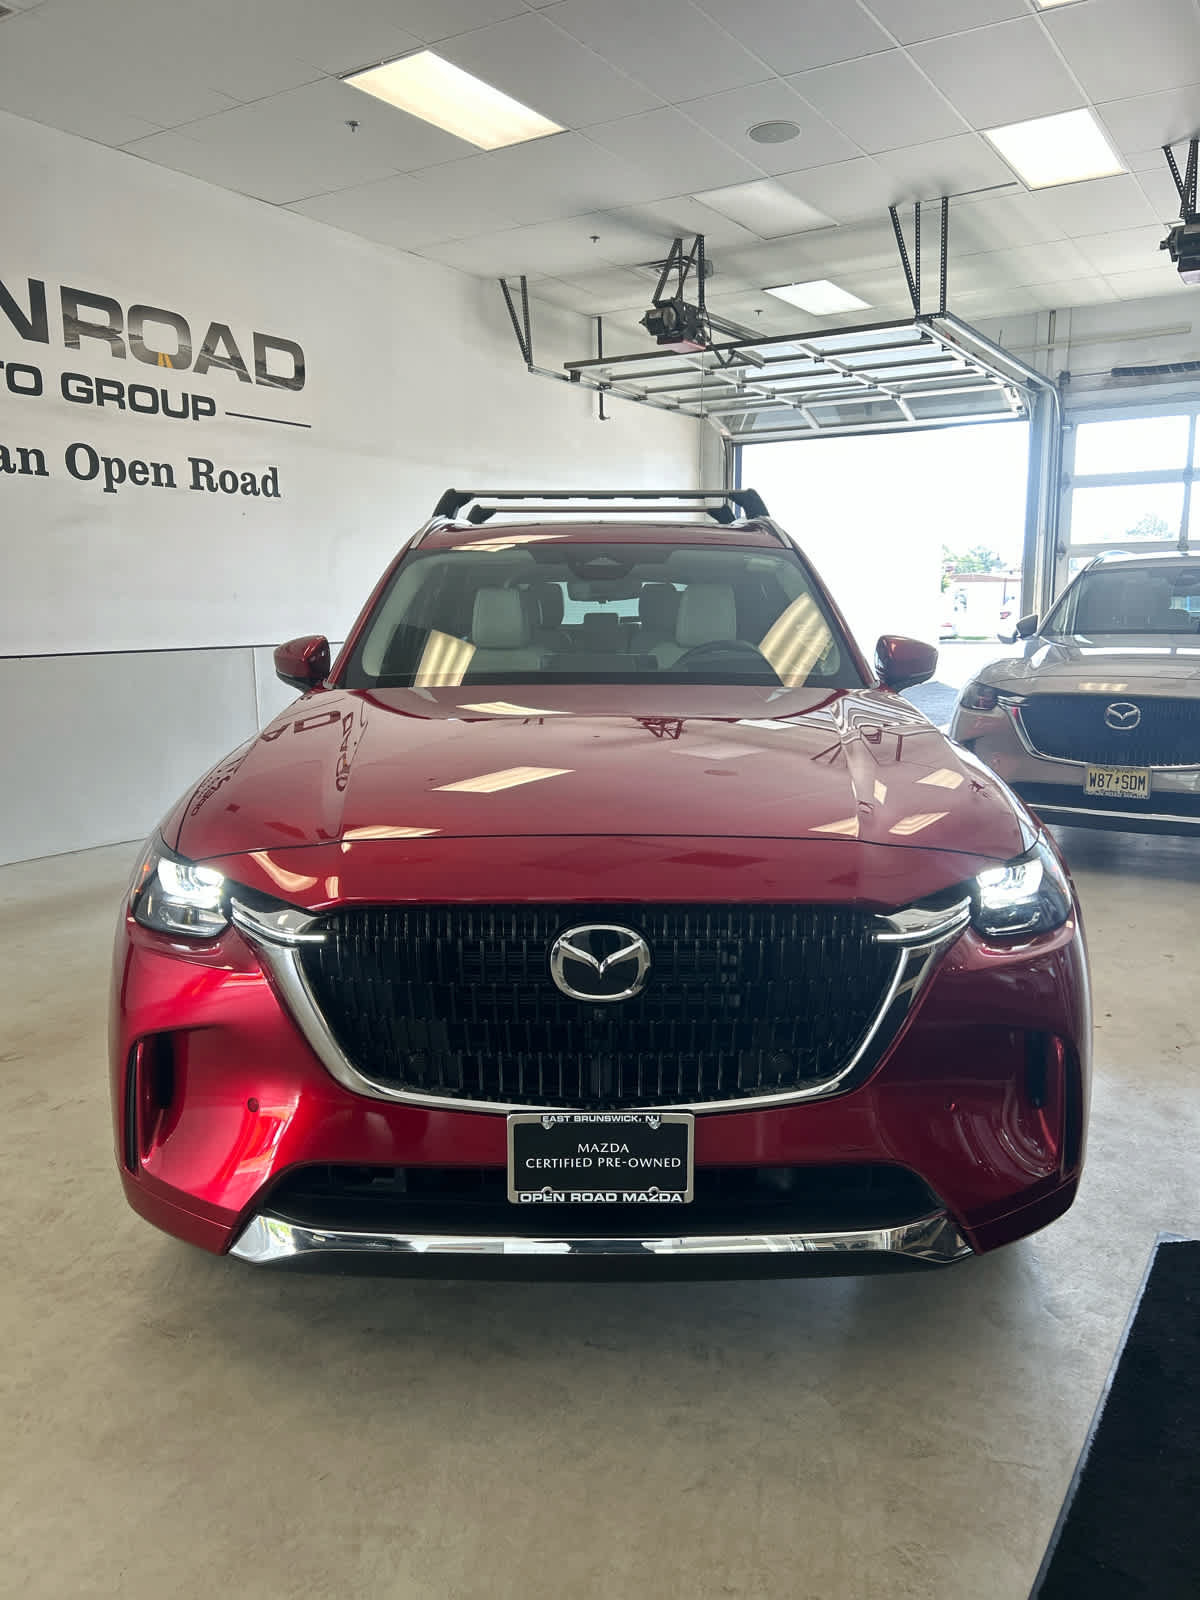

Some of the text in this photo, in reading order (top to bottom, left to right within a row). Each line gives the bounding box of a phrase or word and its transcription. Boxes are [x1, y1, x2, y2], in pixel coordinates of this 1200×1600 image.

[60, 371, 217, 422] GROUP
[64, 442, 177, 494] Open
[187, 456, 282, 499] Road
[541, 1114, 570, 1123] EAST
[645, 1114, 661, 1123] NJ
[577, 1143, 630, 1153] MAZDA
[525, 1157, 682, 1169] CERTIFIED PRE-OWNED
[519, 1192, 683, 1203] OPEN ROAD MAZDA
